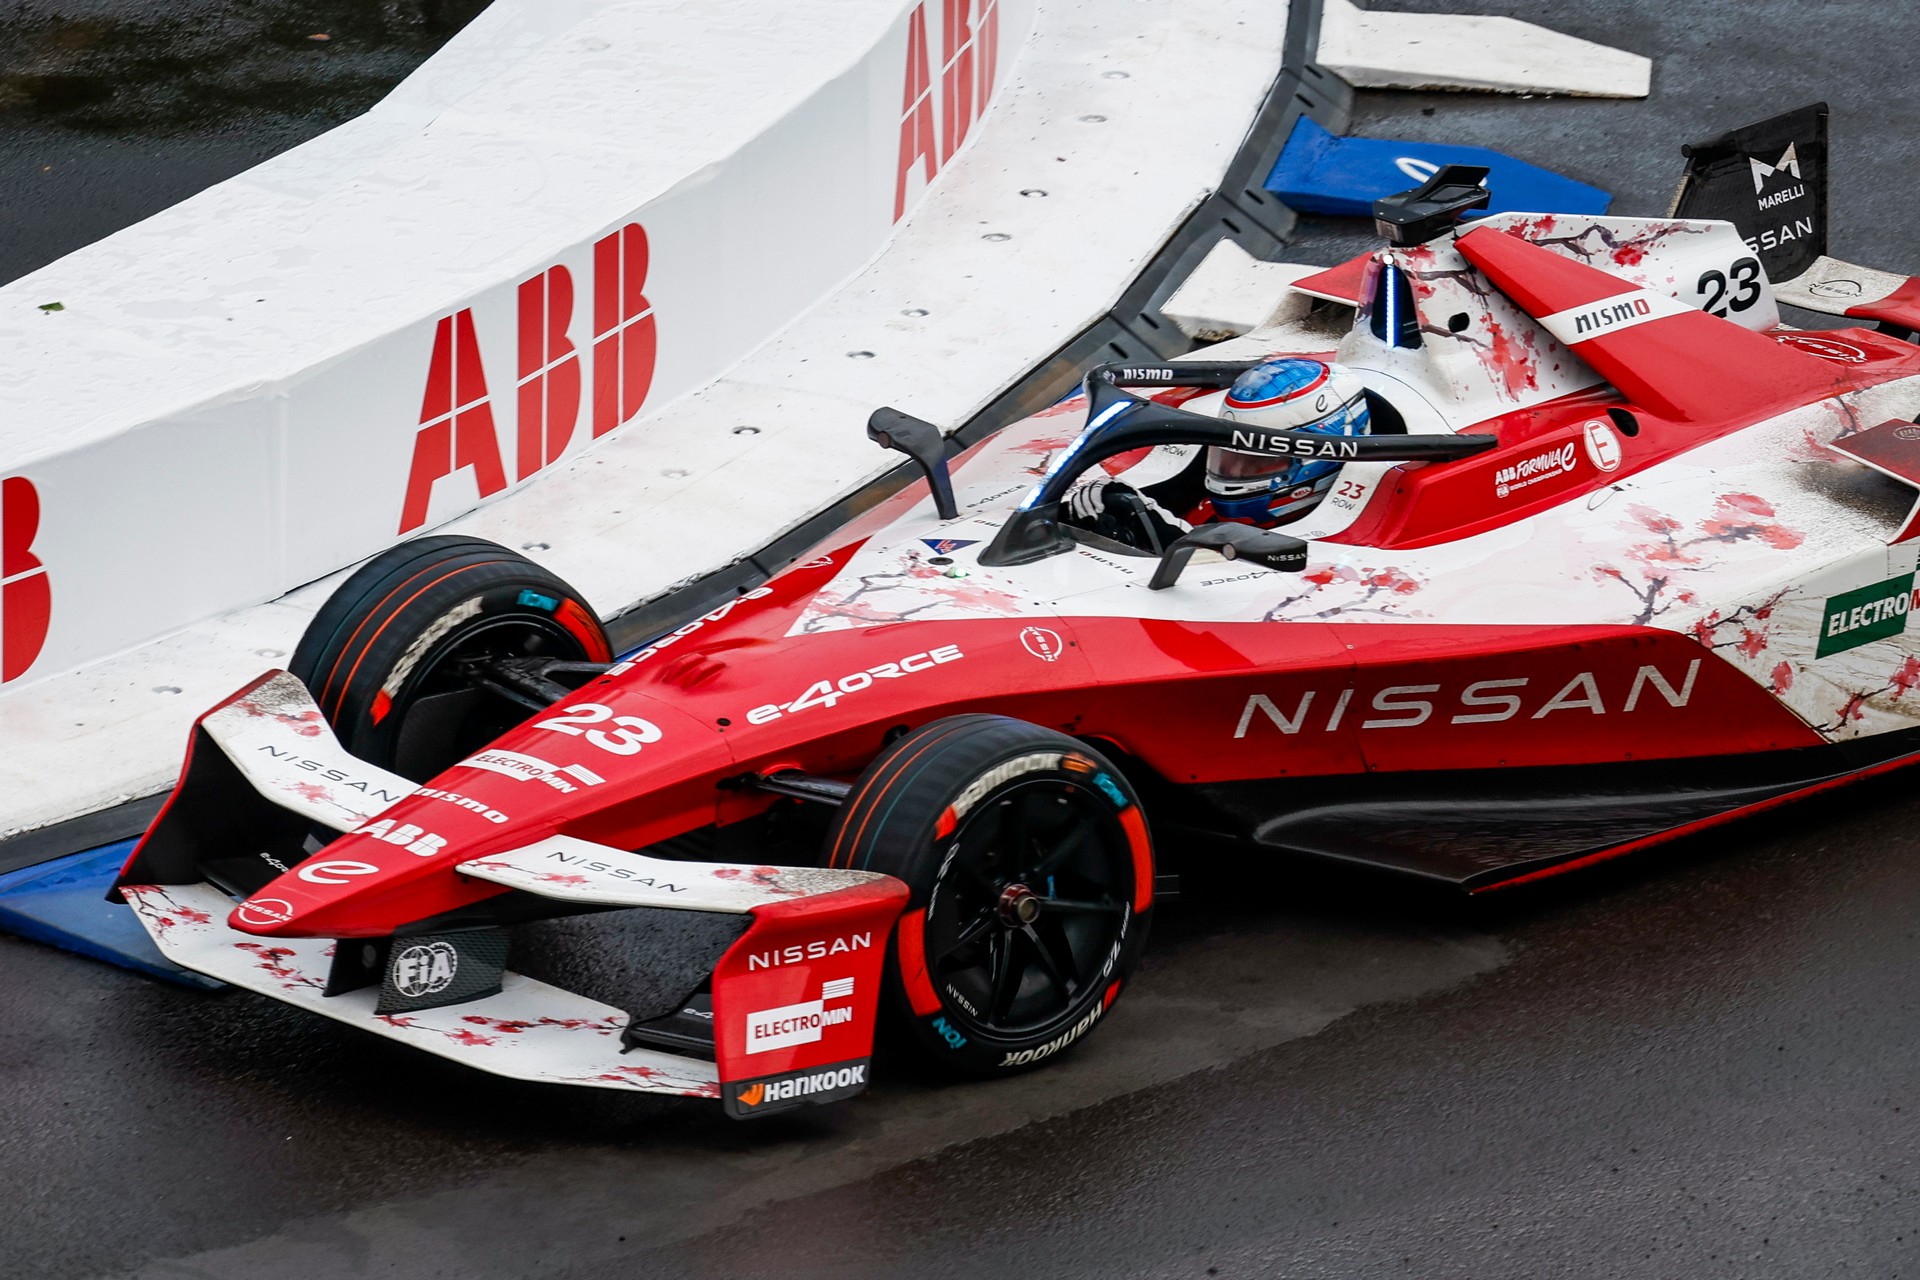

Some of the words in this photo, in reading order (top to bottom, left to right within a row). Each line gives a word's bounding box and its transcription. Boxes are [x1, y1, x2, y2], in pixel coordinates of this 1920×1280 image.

[1757, 184, 1805, 211] MARELLI
[1744, 216, 1813, 255] SSAN
[1697, 257, 1761, 318] 23
[397, 222, 657, 536] ABB
[1232, 430, 1358, 457] NISSAN
[1337, 480, 1366, 500] 23
[1494, 466, 1516, 486] ABB
[1331, 497, 1355, 511] ROW
[1233, 658, 1701, 739] NISSAN
[532, 703, 663, 756] 23
[258, 745, 401, 803] NISSAN
[475, 753, 579, 794] ELECTROMIN
[352, 818, 448, 857] ABB
[546, 851, 688, 893] NISSAN
[239, 901, 292, 922] NISSAN
[748, 931, 872, 971] NISSAN
[946, 982, 979, 1018] NISSAN
[754, 1006, 853, 1040] ELECTROMIN
